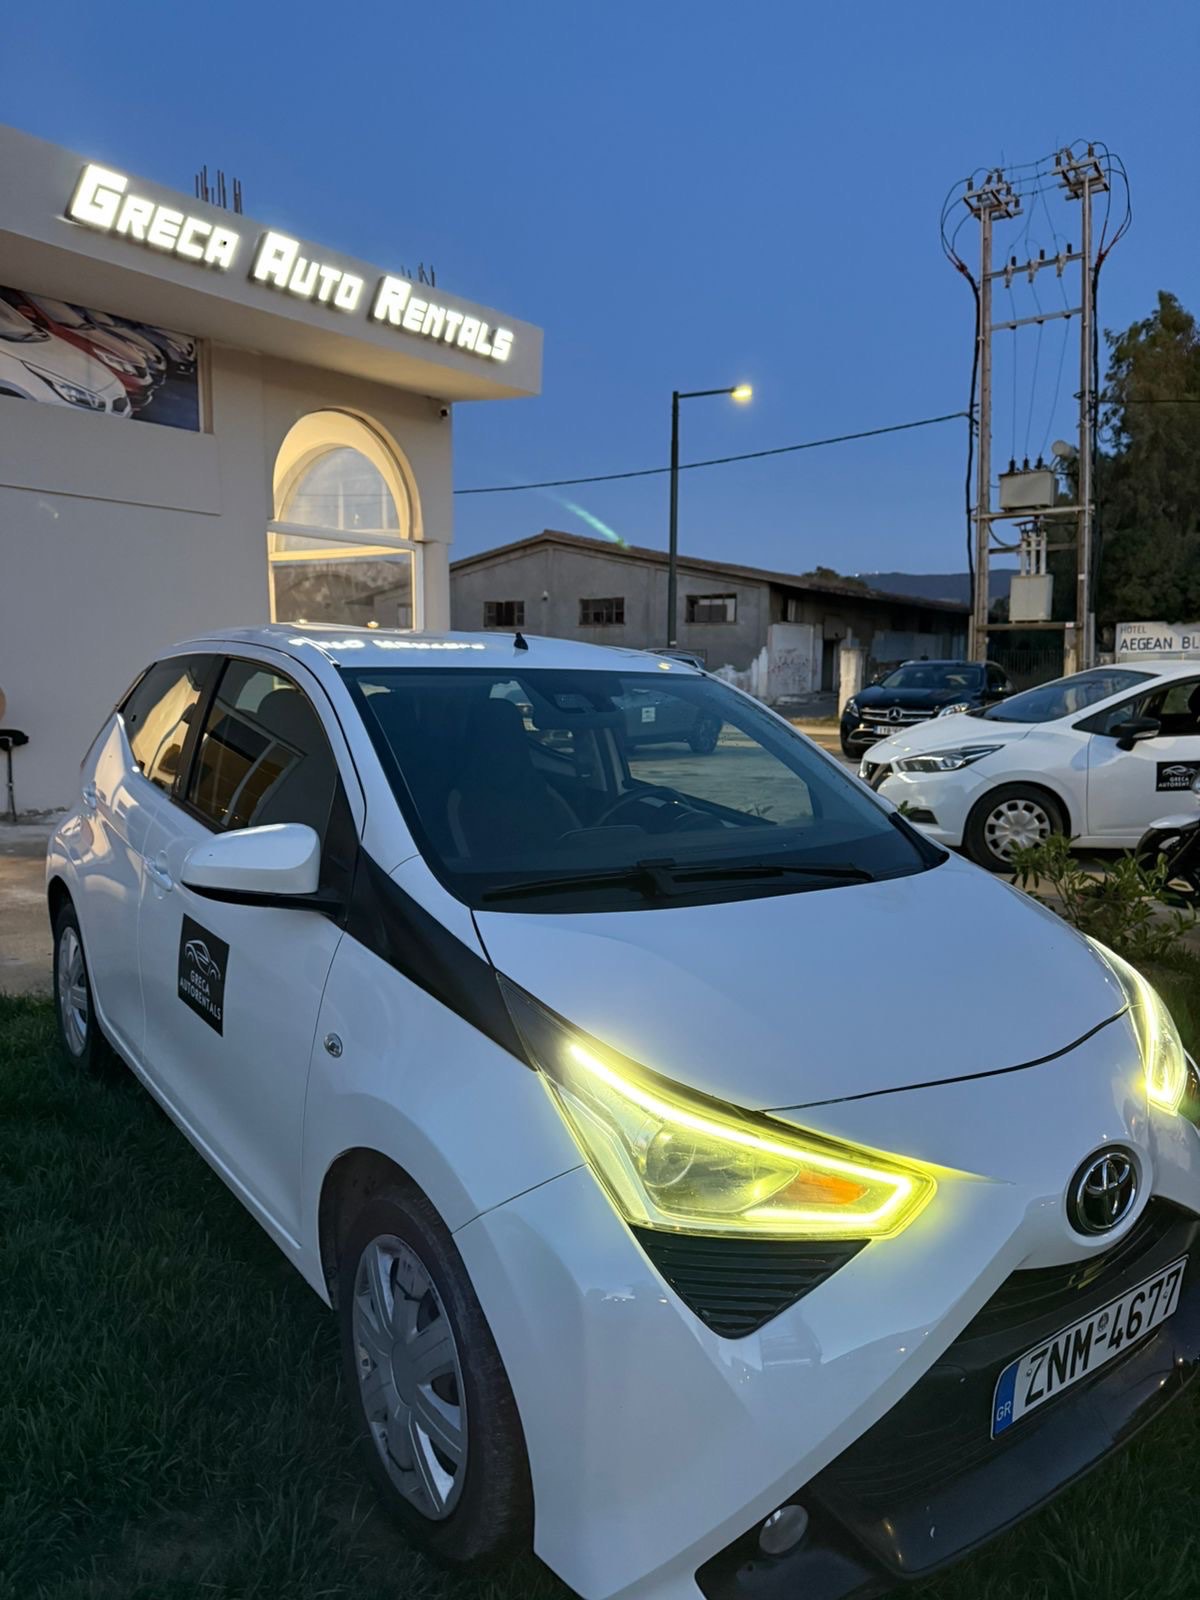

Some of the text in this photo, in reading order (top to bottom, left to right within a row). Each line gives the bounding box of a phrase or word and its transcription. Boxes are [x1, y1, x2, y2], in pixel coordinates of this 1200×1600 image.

[68, 163, 514, 362] GRECA AUTO RENTALS
[1120, 625, 1147, 634] HOTEL
[1120, 636, 1173, 651] AEGEAN
[190, 970, 210, 996] GRECA
[180, 976, 221, 1020] AUTORENTALS
[1025, 1266, 1182, 1408] ZNM-4677
[996, 1400, 1012, 1421] GR
